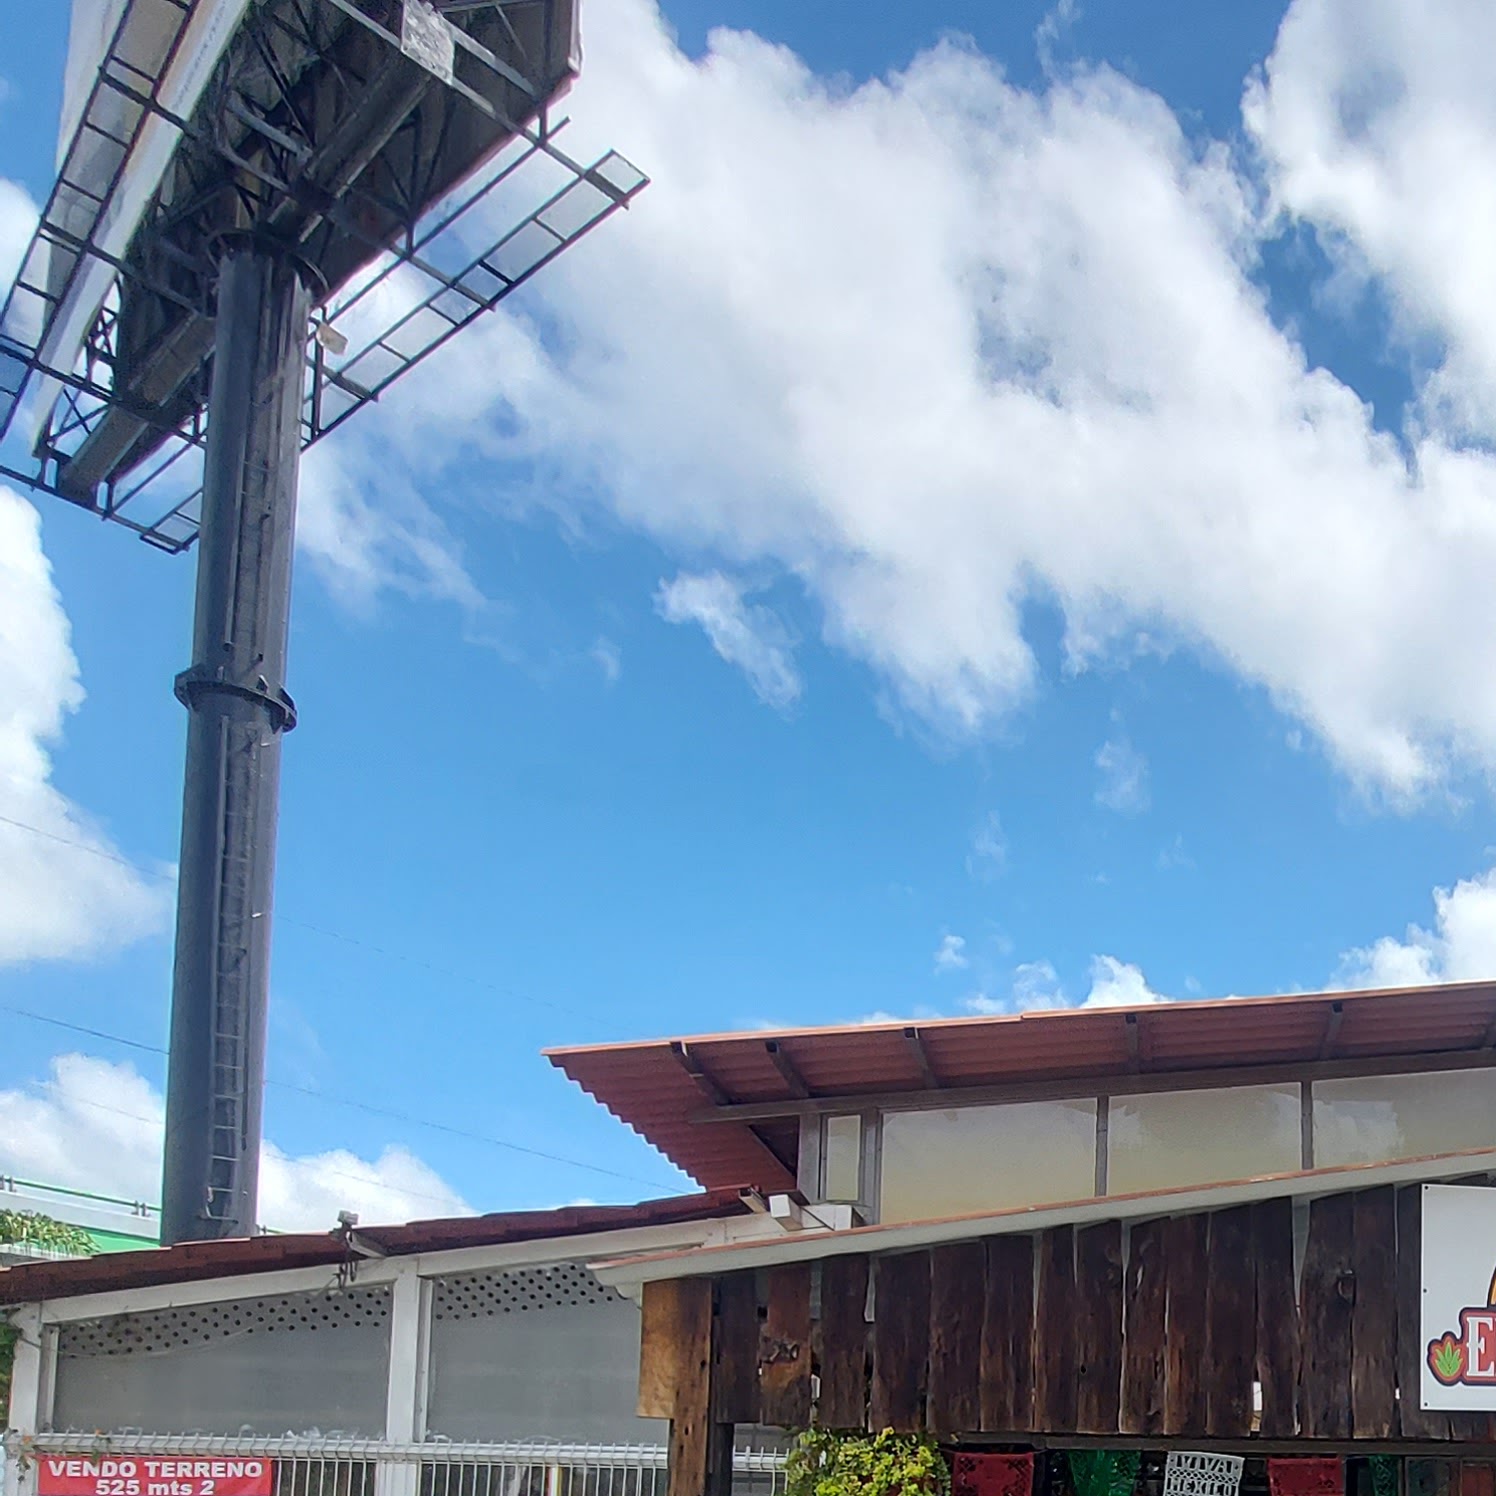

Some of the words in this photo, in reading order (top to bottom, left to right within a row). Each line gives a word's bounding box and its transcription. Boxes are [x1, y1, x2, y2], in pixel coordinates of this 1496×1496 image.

[49, 1461, 137, 1478] VENDO
[144, 1462, 263, 1478] TERRENO
[96, 1479, 140, 1496] 525
[148, 1481, 193, 1496] mts
[201, 1480, 215, 1496] 2
